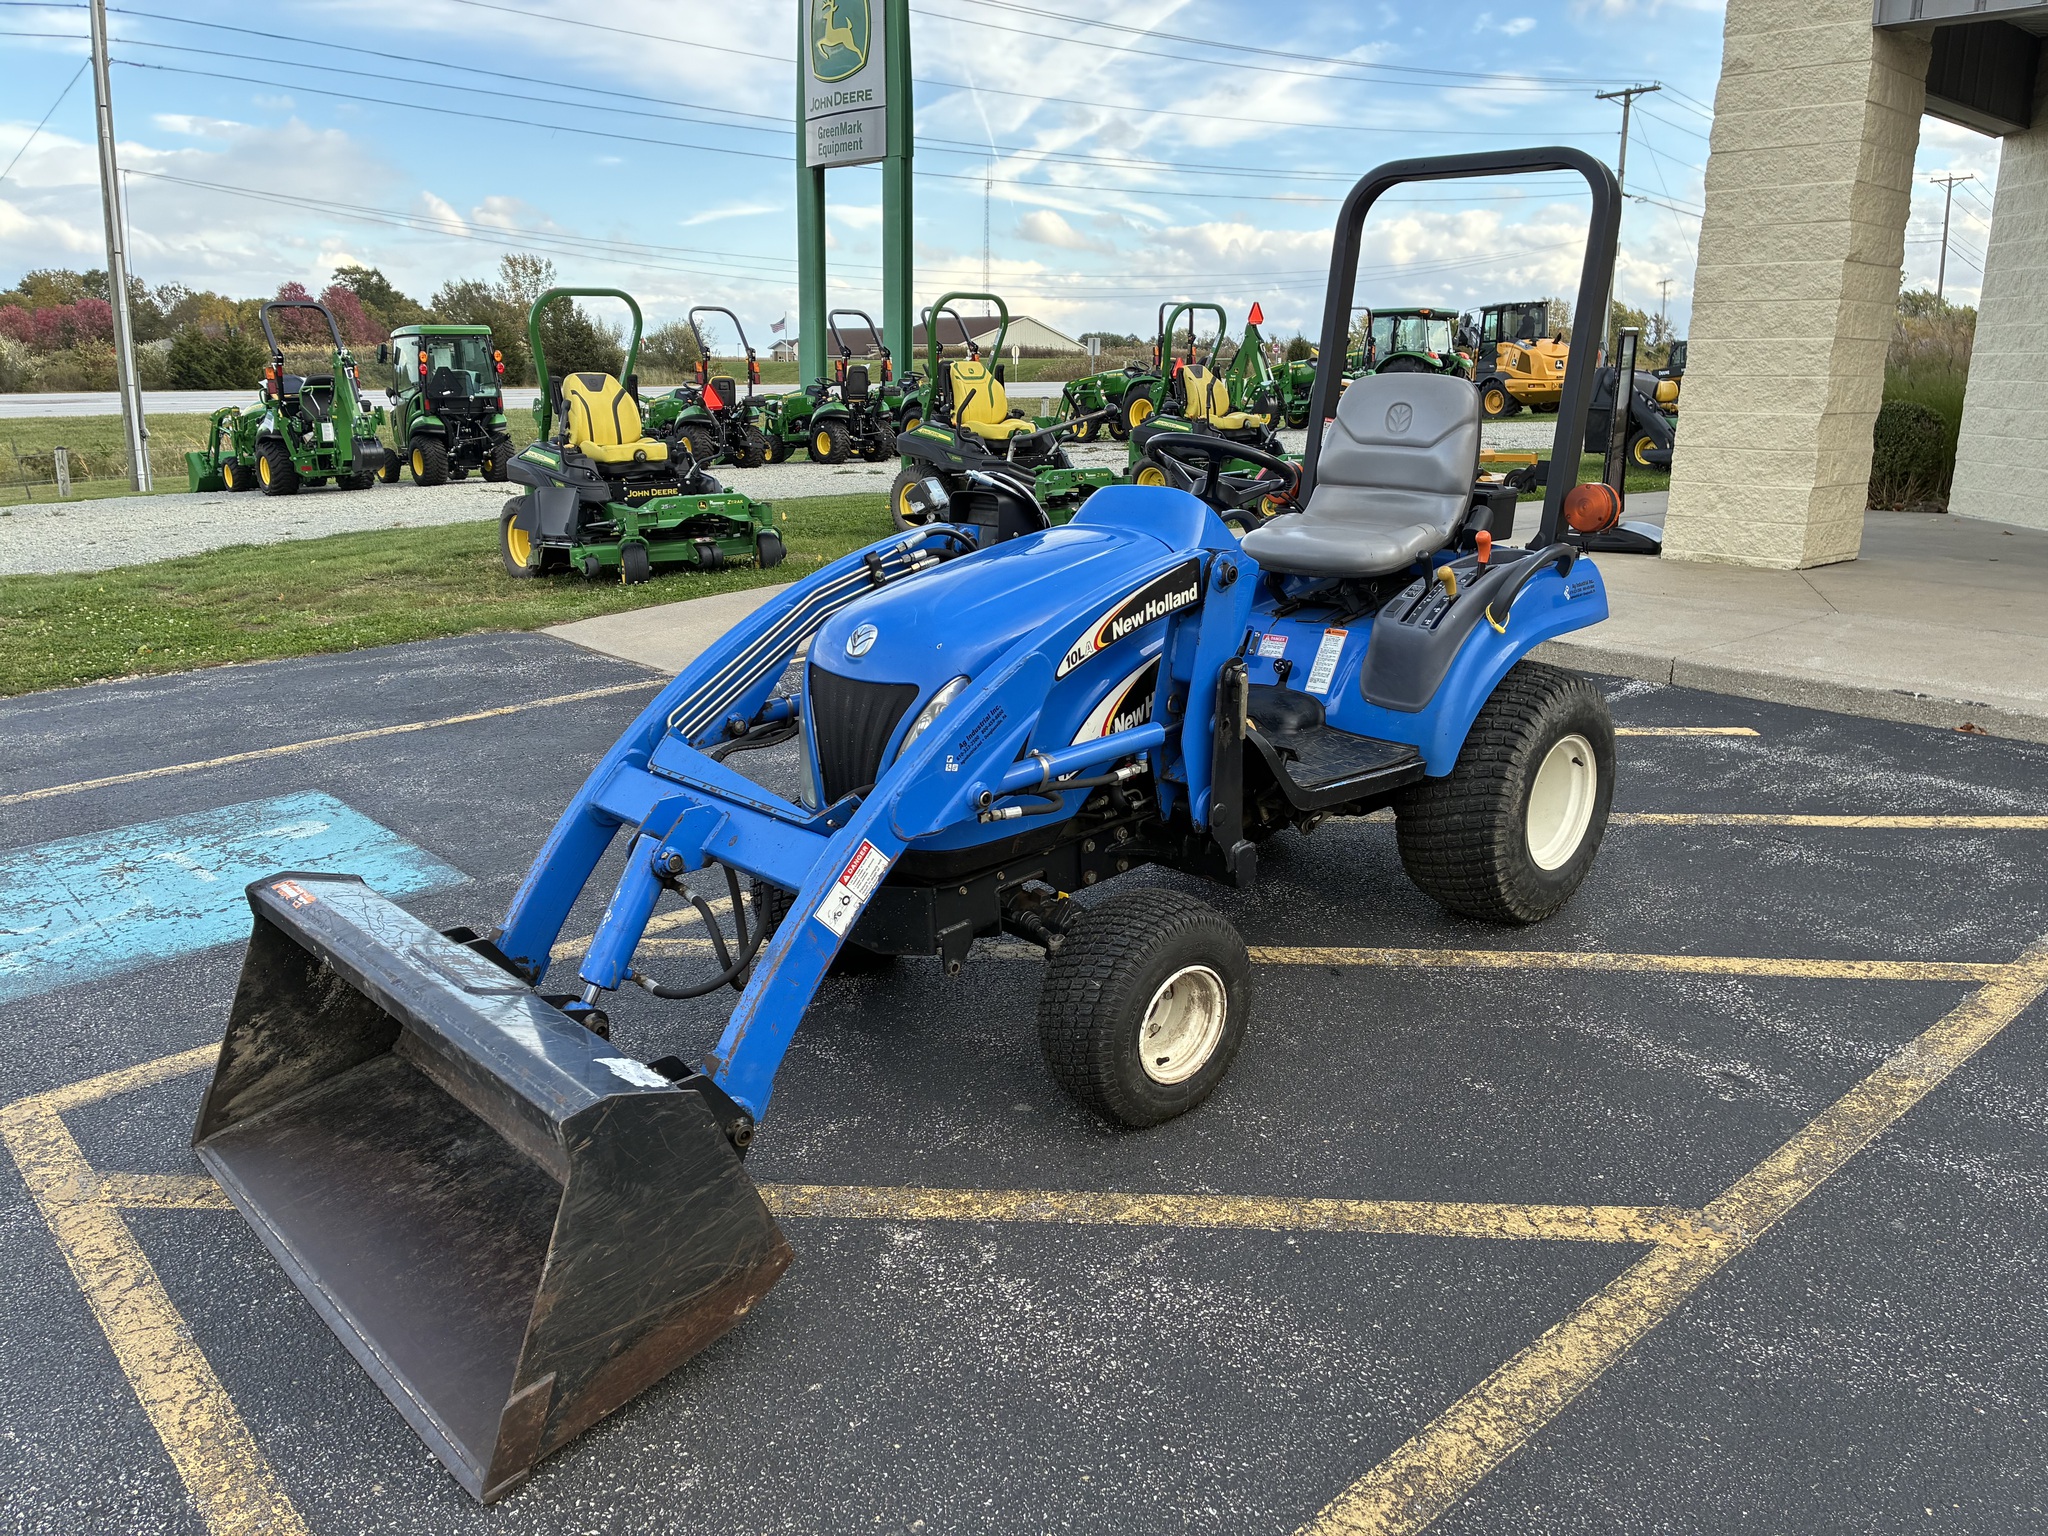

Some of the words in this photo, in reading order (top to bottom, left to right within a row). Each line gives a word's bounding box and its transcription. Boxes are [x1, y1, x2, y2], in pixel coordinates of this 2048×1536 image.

[810, 94, 833, 112] JOHN
[834, 88, 872, 106] DEERE
[818, 120, 862, 138] GreenMark
[818, 138, 862, 157] Equipment
[651, 488, 678, 496] DEERE
[1112, 610, 1144, 640] New
[1146, 582, 1198, 620] Holland
[958, 740, 968, 750] Ag
[966, 714, 991, 741] Industrial
[990, 705, 1002, 716] Inc.
[1114, 704, 1144, 733] New
[848, 845, 869, 874] DANGER
